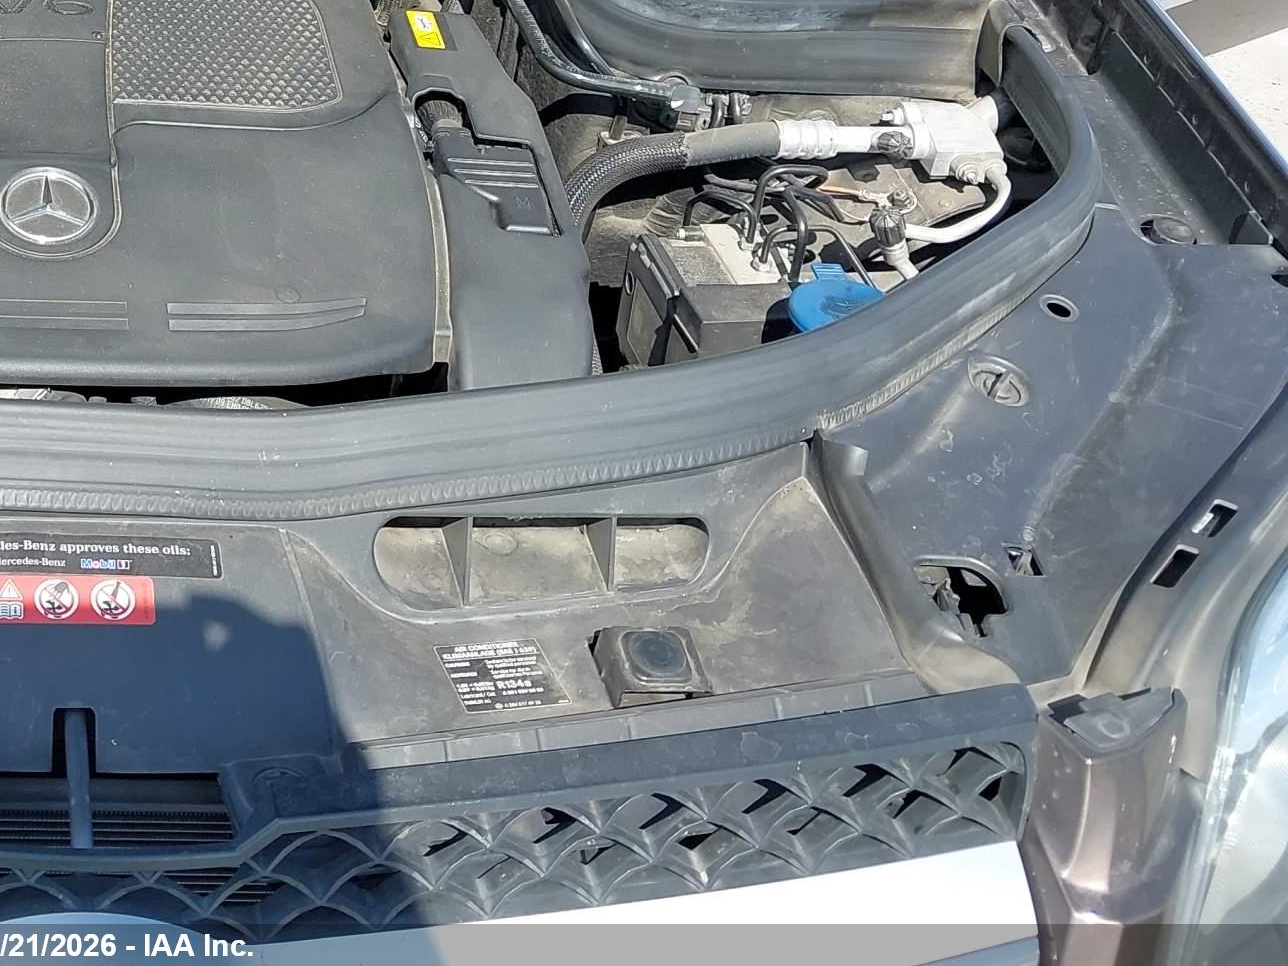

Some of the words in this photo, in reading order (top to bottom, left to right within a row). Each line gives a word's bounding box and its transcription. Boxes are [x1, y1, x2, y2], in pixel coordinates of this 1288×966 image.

[59, 542, 120, 554] approves
[123, 543, 160, 554] these
[162, 545, 191, 555] oils:
[80, 558, 116, 570] Mobil
[496, 679, 532, 689] R134a
